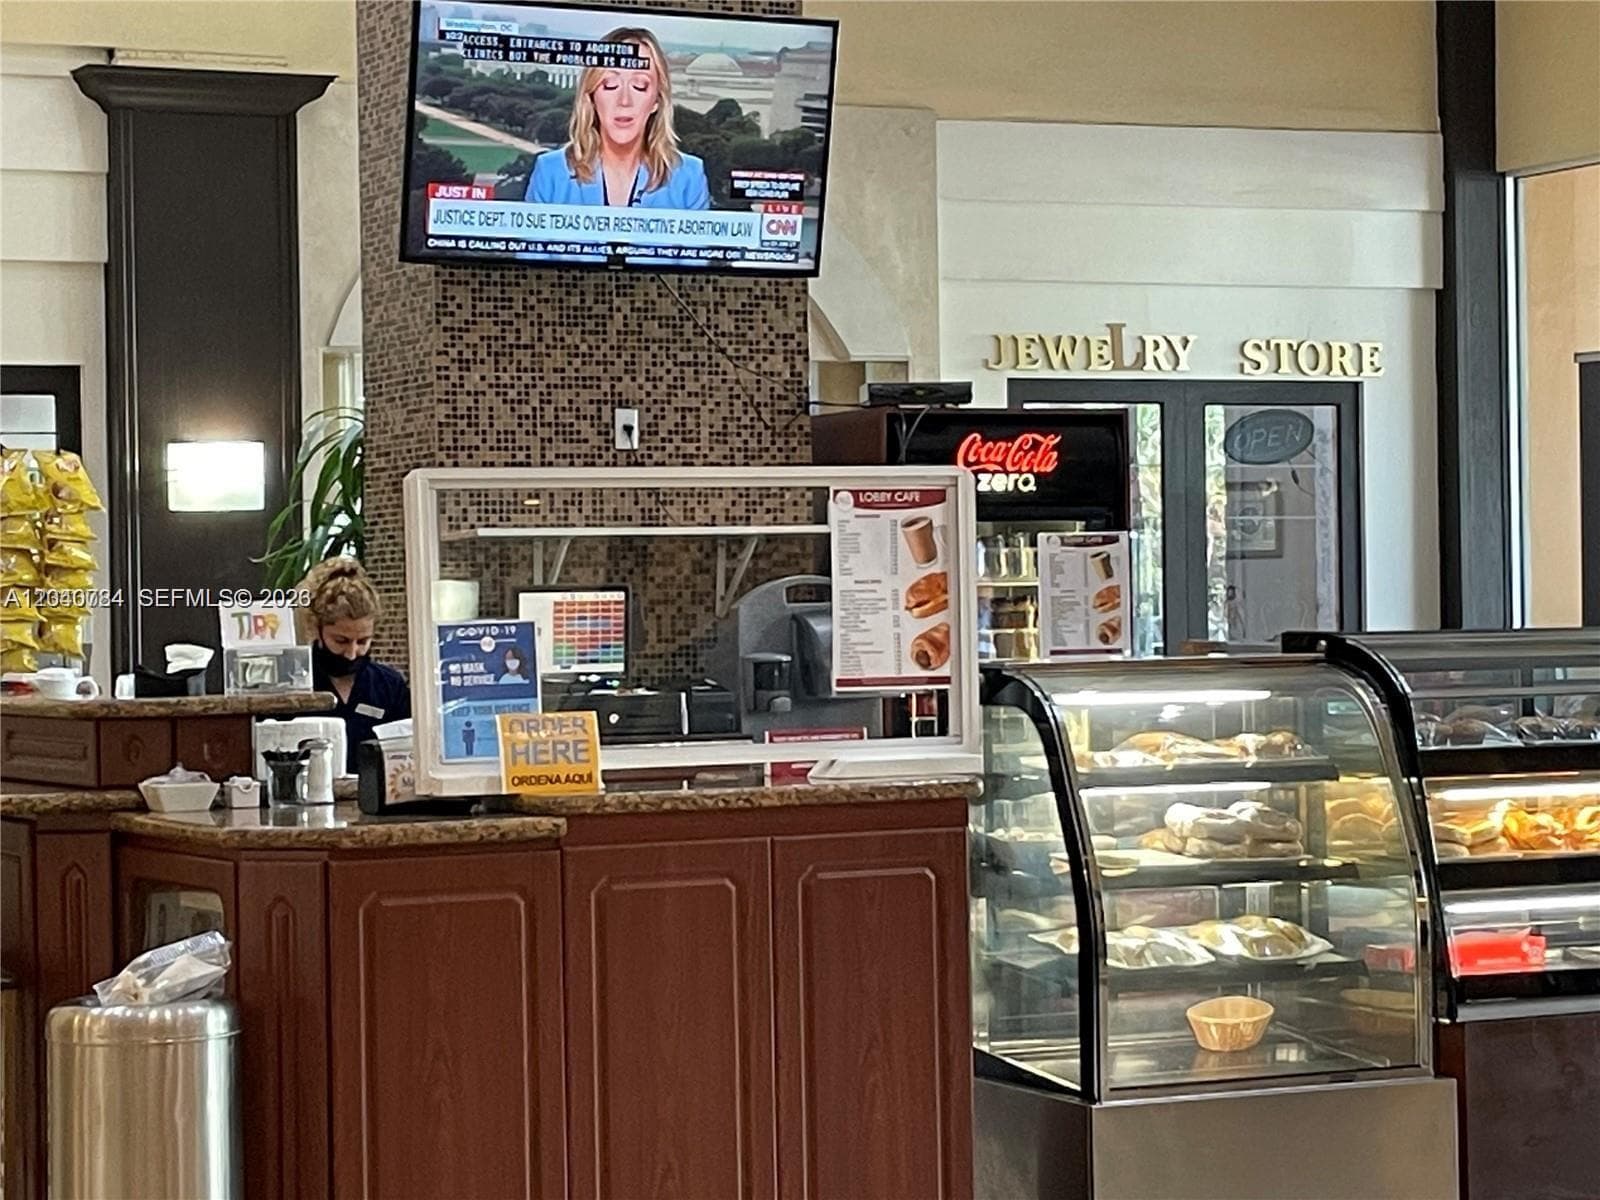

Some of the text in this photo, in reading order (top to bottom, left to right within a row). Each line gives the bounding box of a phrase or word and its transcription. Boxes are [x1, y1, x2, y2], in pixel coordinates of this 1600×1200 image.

[463, 48, 504, 60] CLINICS
[556, 54, 598, 66] PROBLEM
[603, 57, 616, 67] IS
[620, 58, 650, 69] RIGHT
[569, 42, 582, 52] TO
[586, 43, 634, 55] ABORTION
[434, 185, 486, 199] JUST IN
[767, 203, 799, 214] LIVE
[433, 209, 753, 237] JUSTICE DEPT. TO SUE TEXAS OVER RESTRICTIVE ABORTION LAW
[766, 218, 798, 236] CNN
[427, 238, 457, 248] CHINA
[468, 240, 506, 250] CALLING
[508, 241, 526, 251] OUT
[547, 243, 566, 253] AND
[657, 248, 680, 257] THEY
[680, 249, 699, 258] ARE
[698, 249, 724, 259] MORE
[983, 323, 1386, 378] JEWELRY STORE
[1233, 421, 1301, 453] OPEN
[957, 433, 1062, 473] Coca-Cola
[977, 473, 1037, 492] zero
[859, 491, 892, 502] LOBBY
[456, 625, 517, 637] COVID-19
[508, 716, 588, 738] ORDER
[511, 739, 592, 766] HERE
[512, 774, 564, 788] ORDENA
